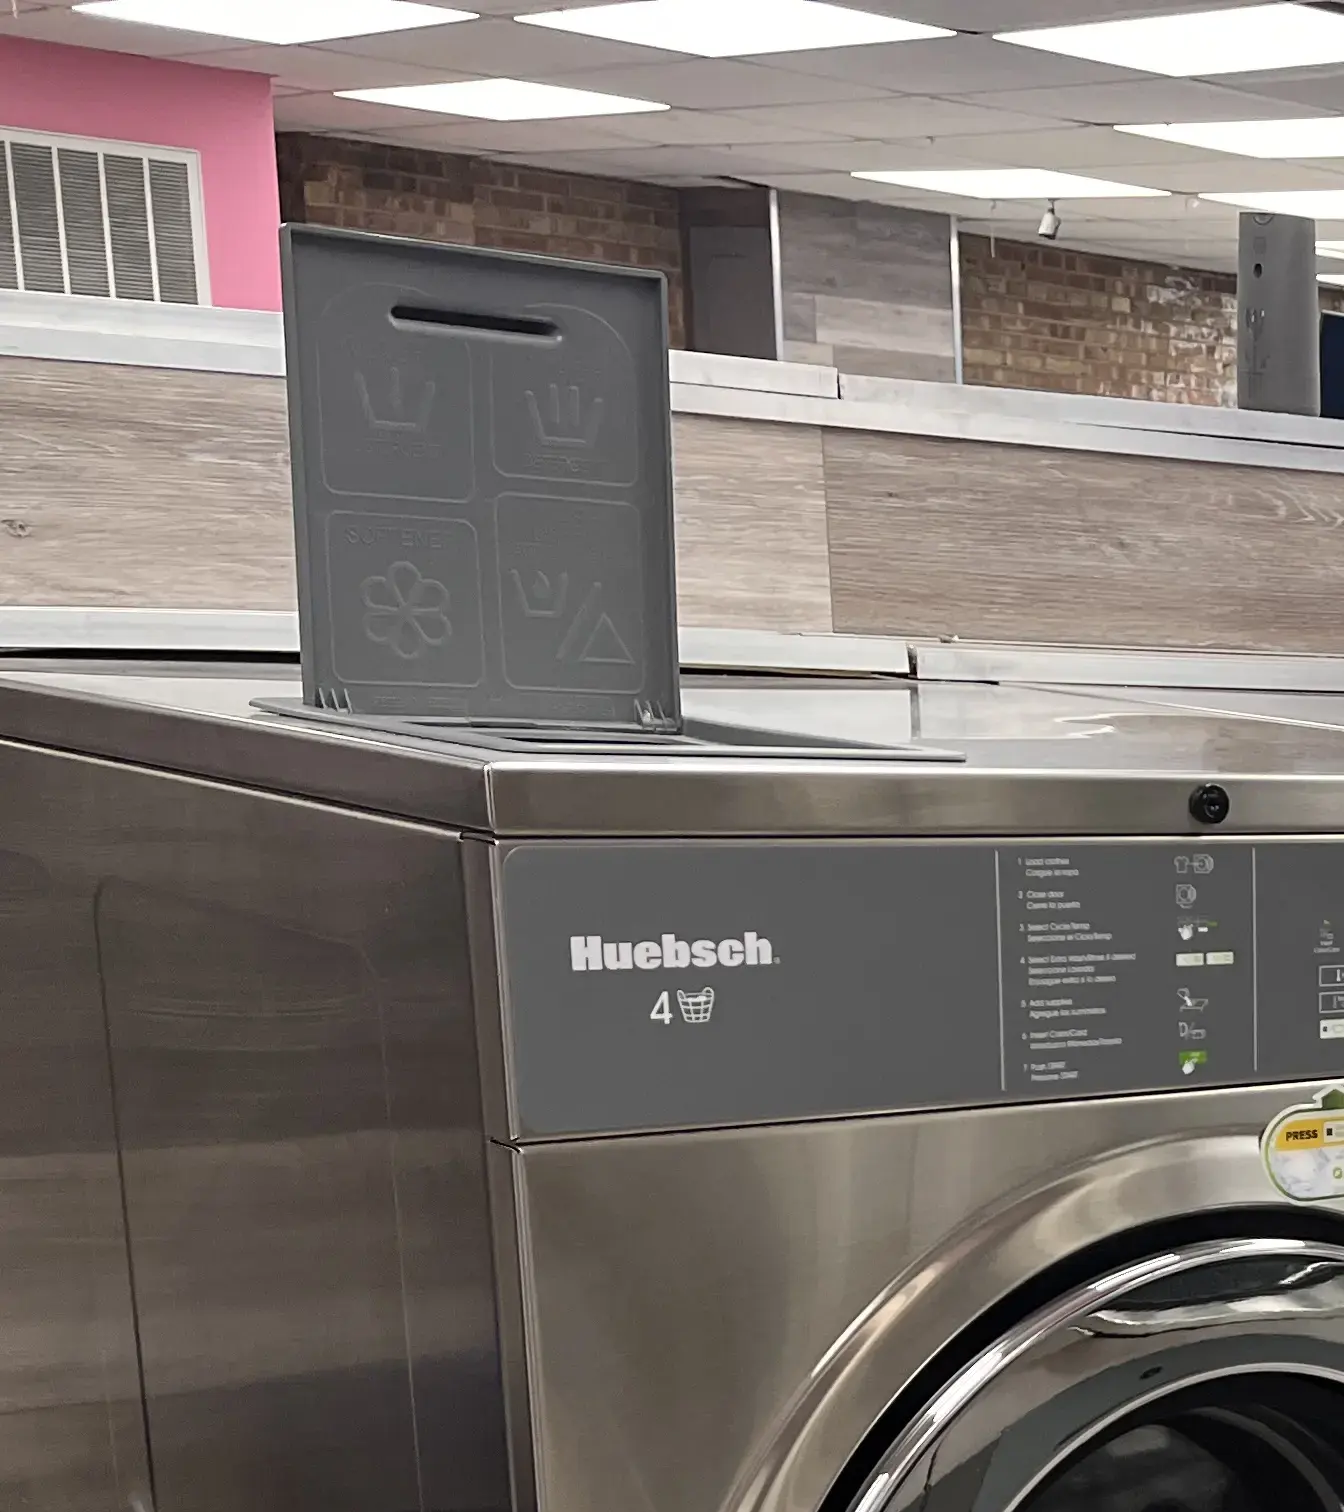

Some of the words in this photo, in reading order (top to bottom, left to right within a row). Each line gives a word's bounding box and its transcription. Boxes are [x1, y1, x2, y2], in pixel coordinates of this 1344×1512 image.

[570, 931, 773, 972] Huebsch
[649, 990, 673, 1025] 4
[1285, 1128, 1319, 1143] PRESS
